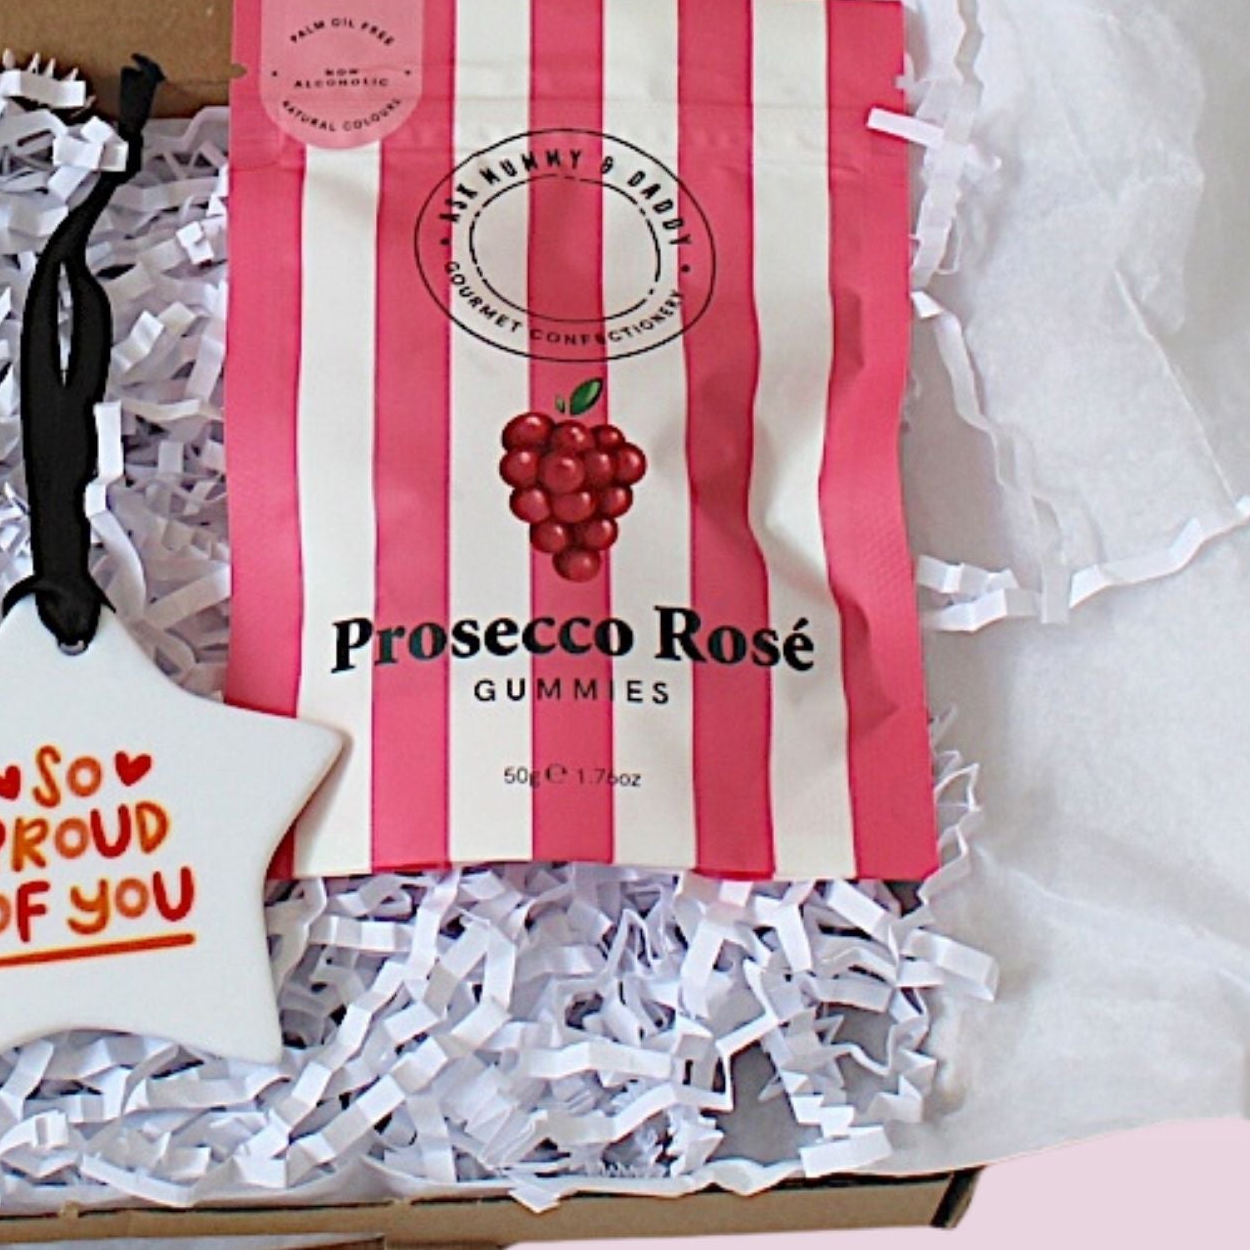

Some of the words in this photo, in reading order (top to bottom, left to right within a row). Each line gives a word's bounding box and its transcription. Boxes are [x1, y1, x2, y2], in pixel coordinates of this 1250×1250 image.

[290, 20, 325, 43] PALM
[361, 22, 394, 46] FREE
[294, 78, 388, 88] ALCOHOLIC
[283, 100, 336, 132] NATURAL
[439, 183, 478, 223] ASK
[479, 150, 581, 186] MUMMY
[627, 171, 691, 246] DADDY
[445, 261, 522, 333] GOURMET
[530, 289, 685, 345] CONFECTIONERY
[330, 617, 634, 673] Prosecco
[654, 605, 815, 671] Rosé
[473, 678, 670, 704] GUMMIES
[32, 745, 102, 808] SO
[504, 766, 540, 787] 50g
